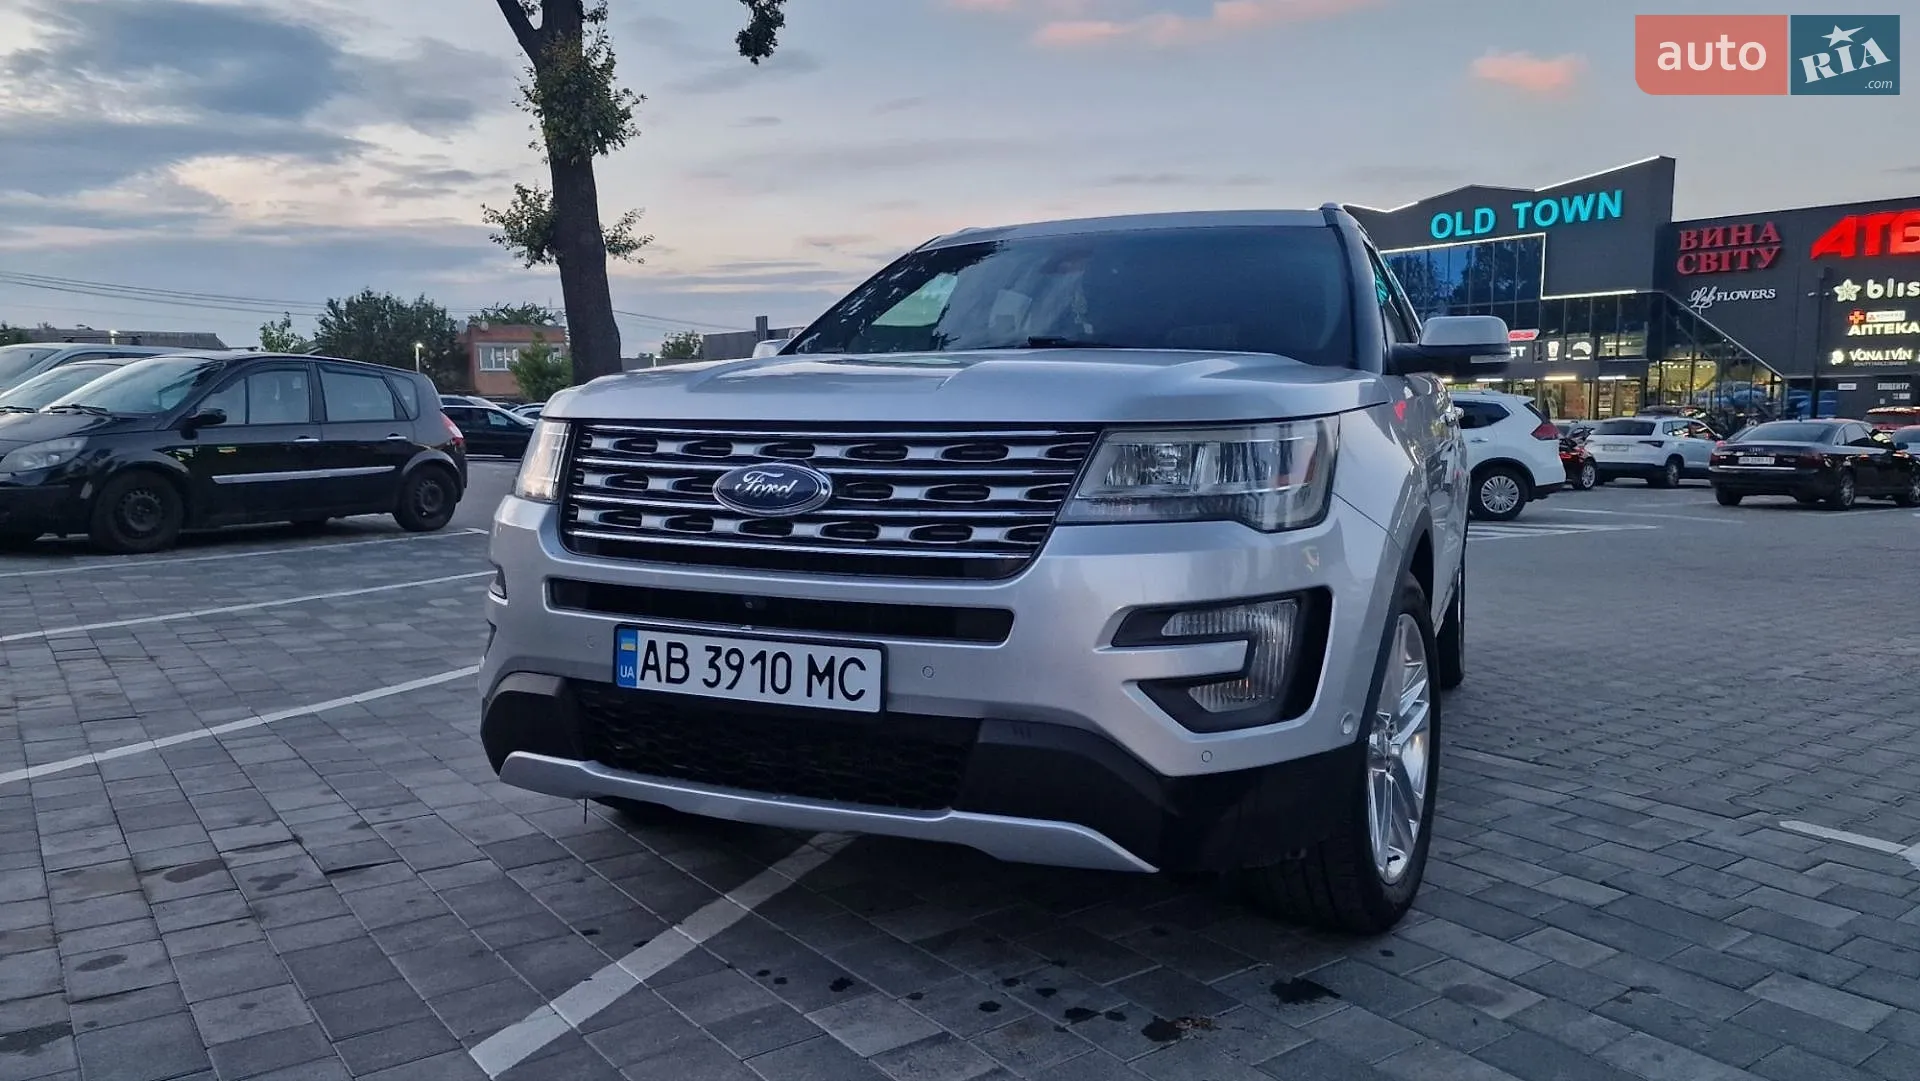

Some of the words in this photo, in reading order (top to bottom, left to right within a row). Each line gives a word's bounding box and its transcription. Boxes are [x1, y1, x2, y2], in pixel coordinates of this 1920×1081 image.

[1430, 207, 1496, 239] OLD
[1512, 190, 1623, 229] TOWN
[1678, 220, 1781, 251] ВИНА
[1810, 208, 1920, 261] АТБ
[1676, 245, 1780, 275] СВІТУ
[1716, 288, 1776, 302] FLOWERS
[1847, 321, 1920, 336] АПТЕКА
[735, 470, 799, 495] Ford
[620, 666, 635, 679] UA
[640, 639, 690, 685] AB
[702, 645, 792, 695] 3910
[806, 653, 867, 702] MC
